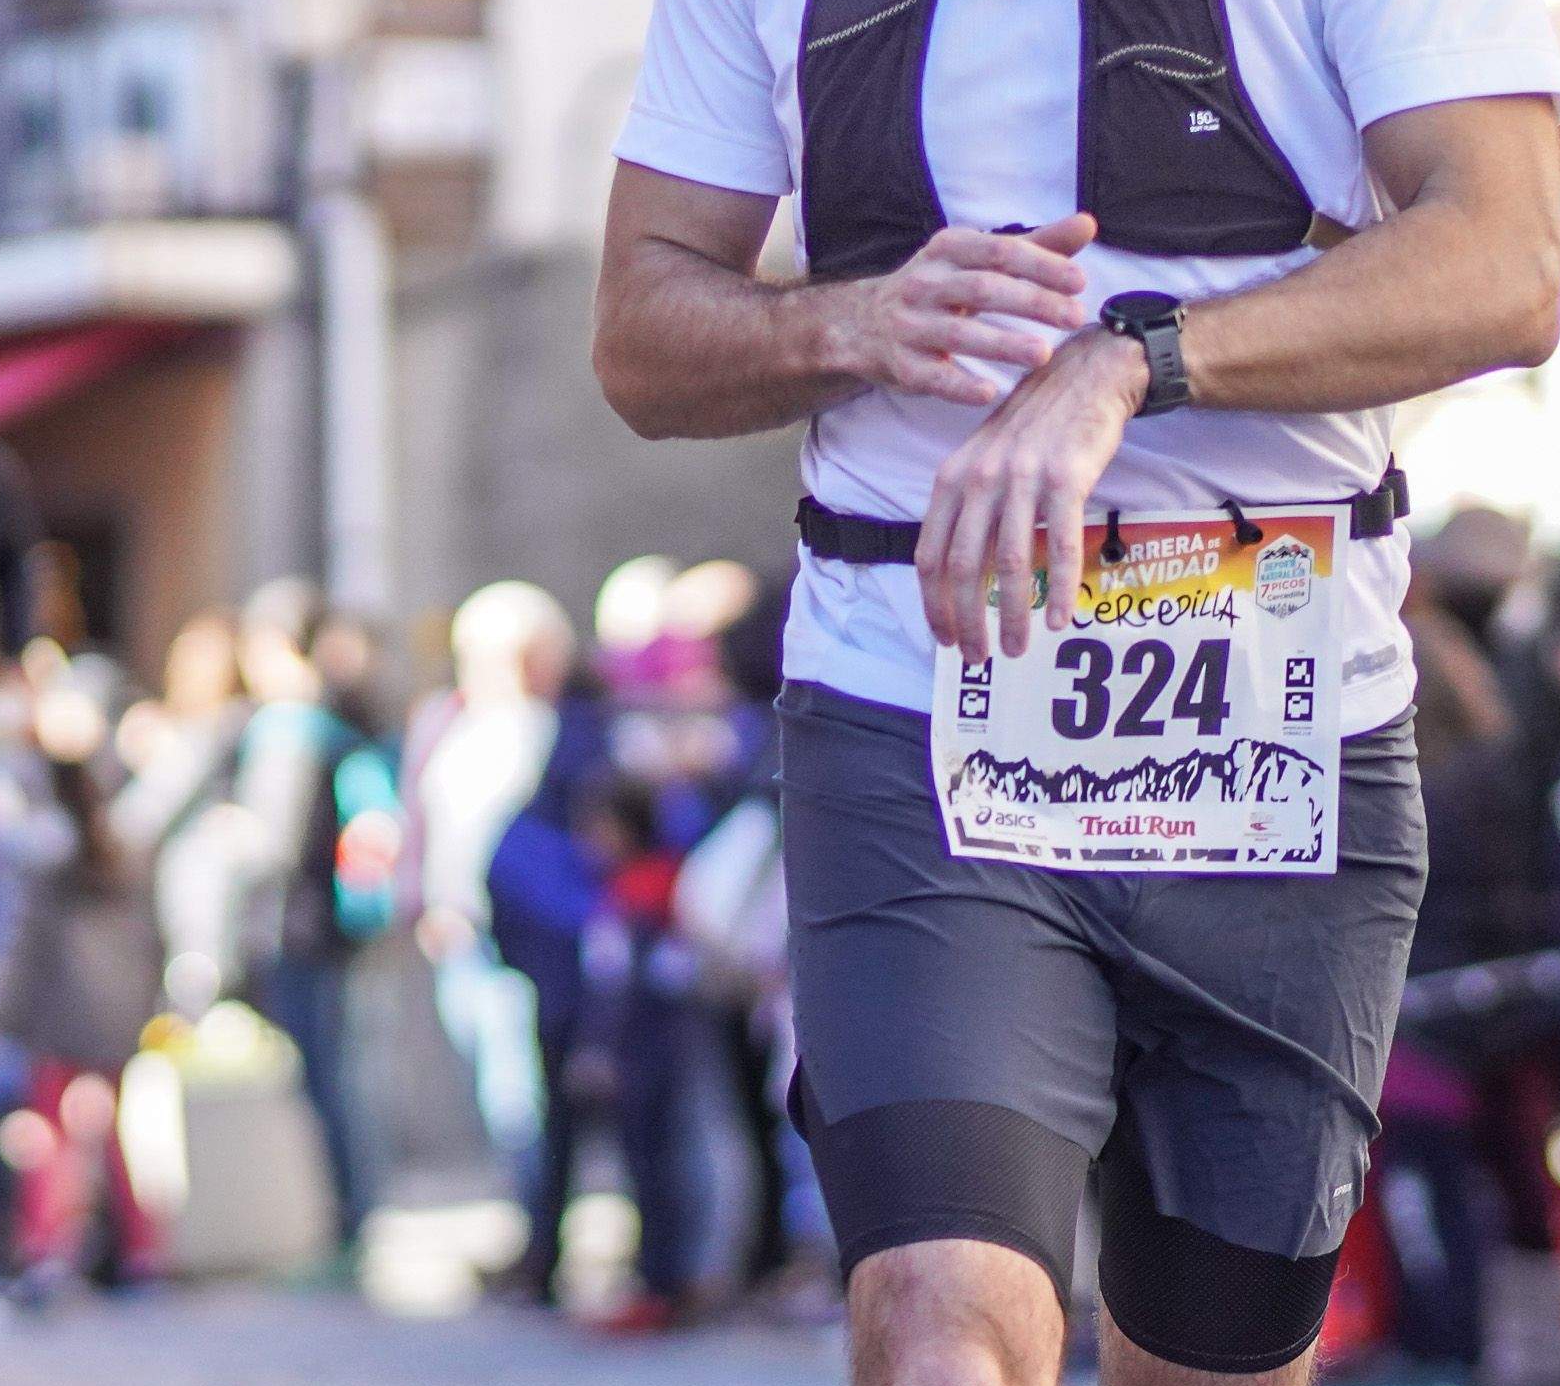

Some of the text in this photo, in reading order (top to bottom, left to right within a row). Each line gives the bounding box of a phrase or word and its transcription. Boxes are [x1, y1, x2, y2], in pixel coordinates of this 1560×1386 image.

[1100, 551, 1220, 594] NAVIDAD
[1261, 577, 1306, 598] 7 PICOS
[1050, 638, 1231, 741] 324
[995, 812, 1036, 829] asics
